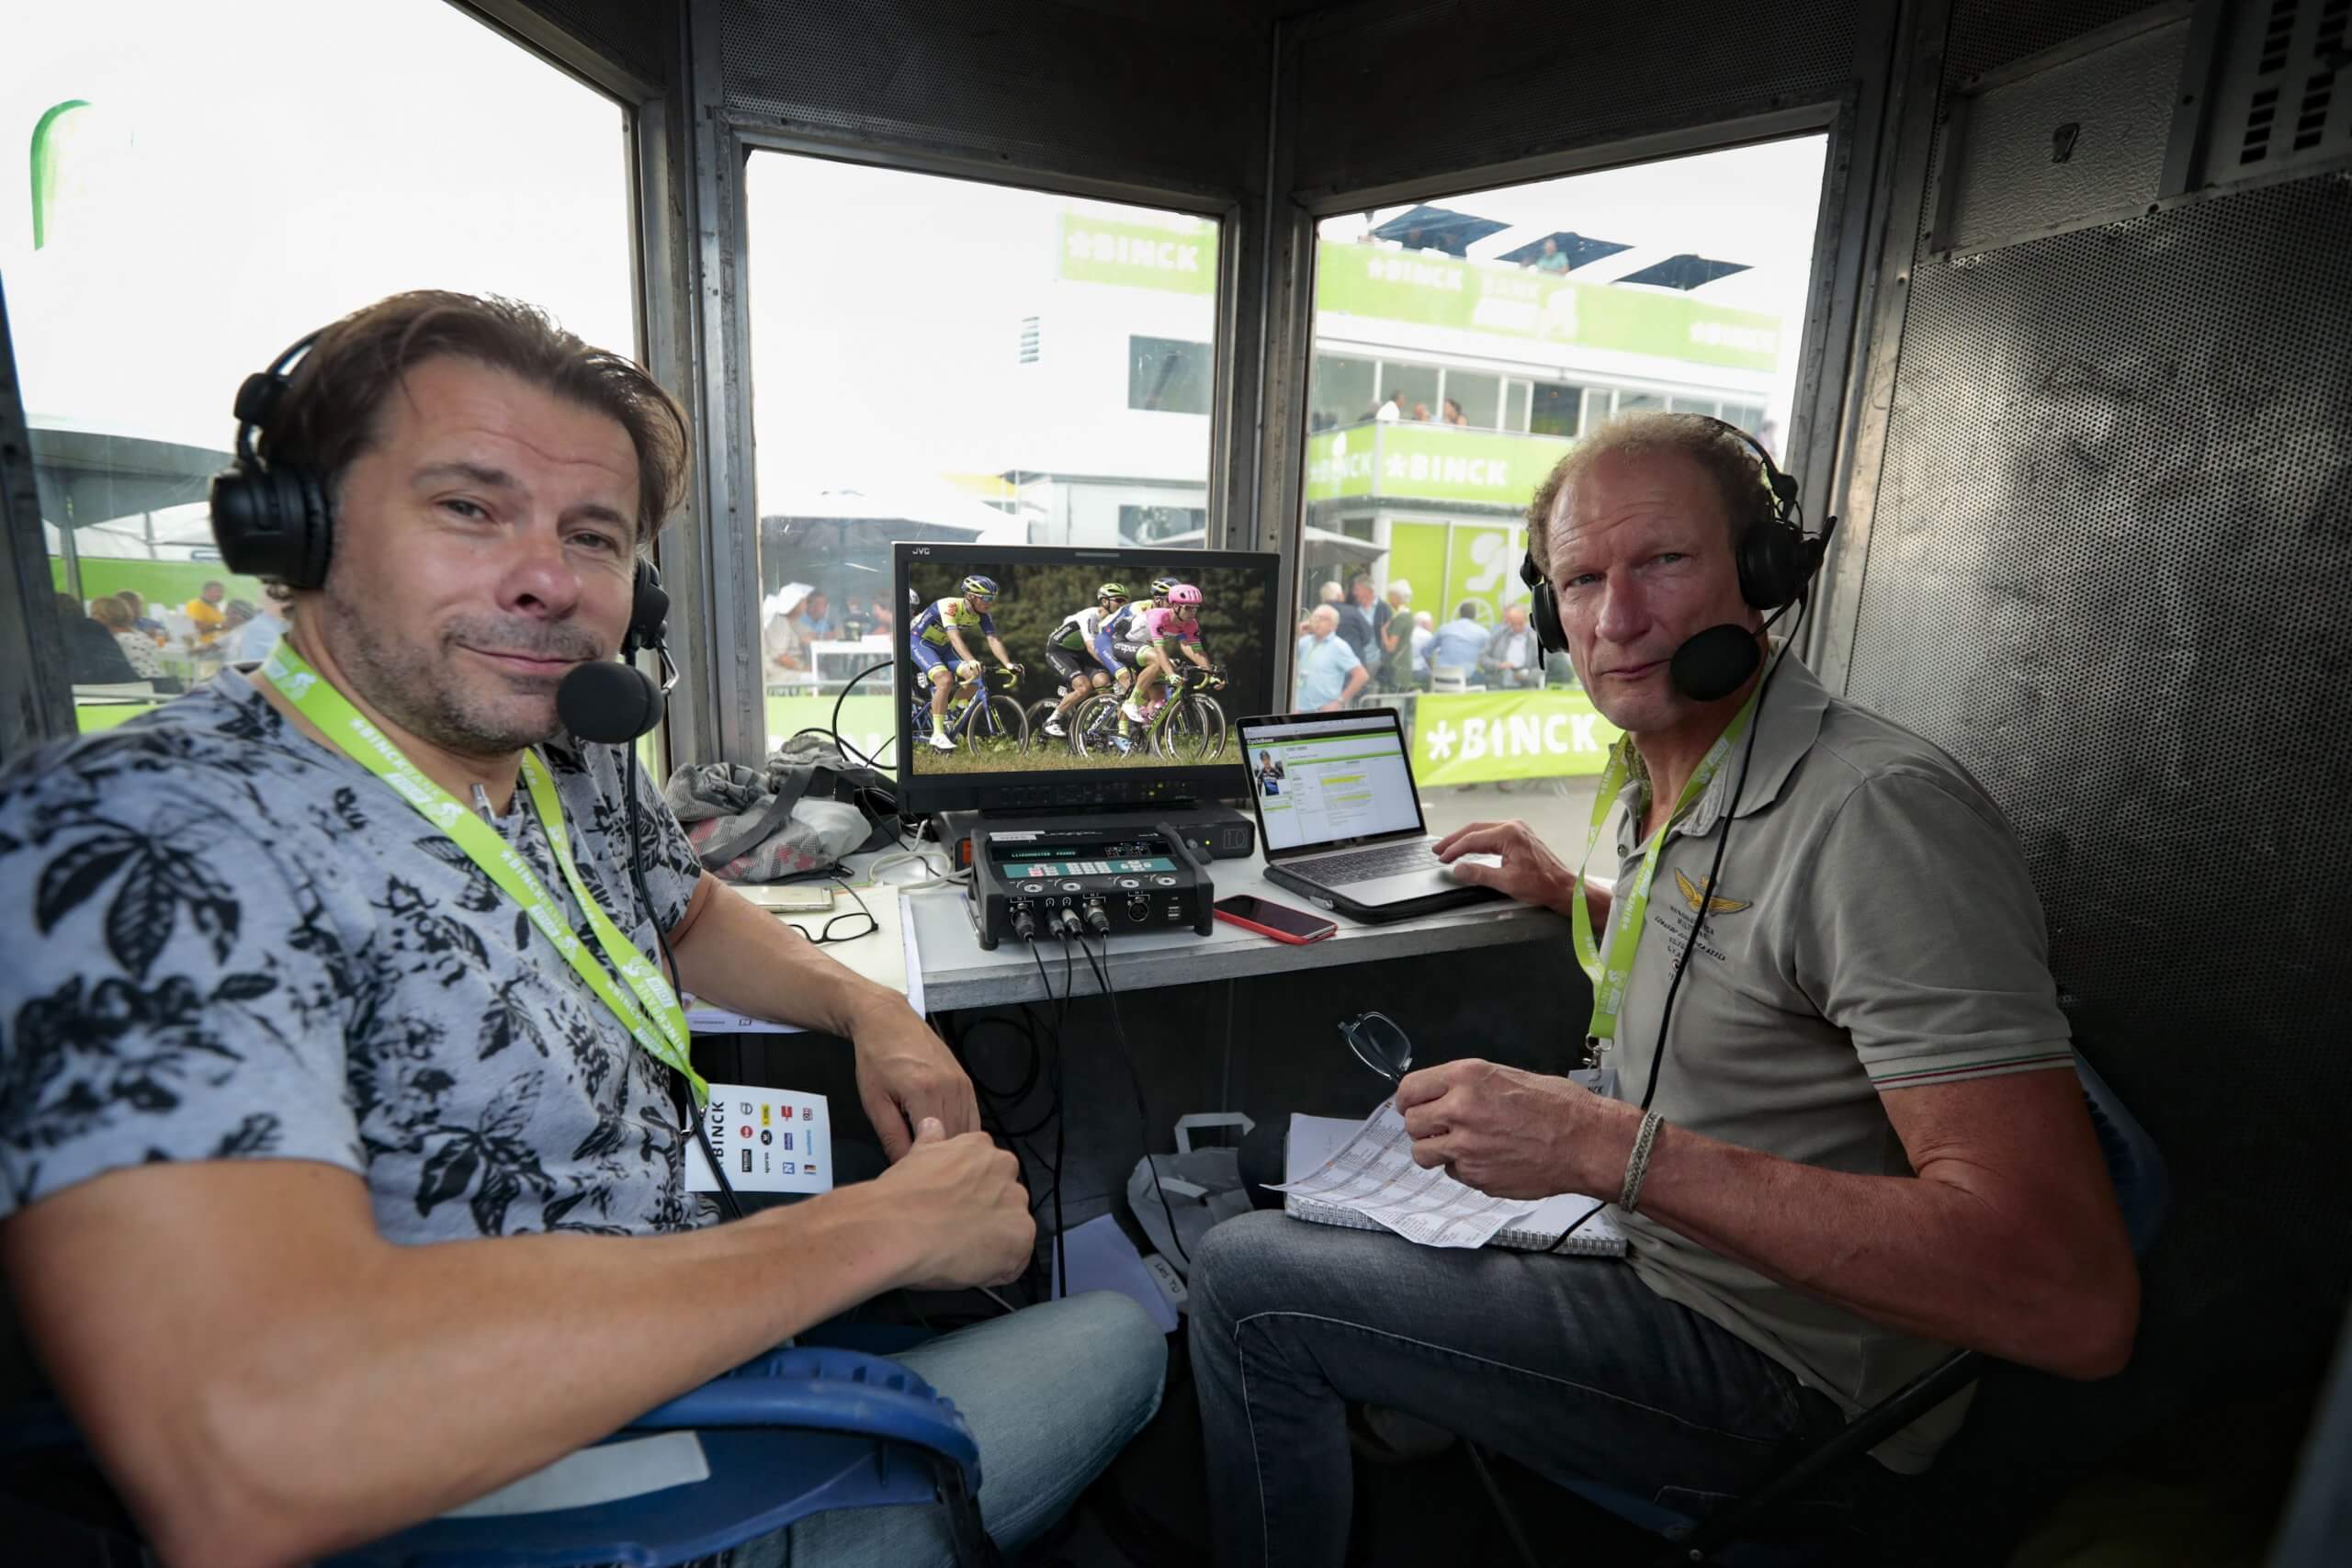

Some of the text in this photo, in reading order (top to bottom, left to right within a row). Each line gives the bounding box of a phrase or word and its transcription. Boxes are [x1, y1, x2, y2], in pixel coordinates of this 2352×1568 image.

[1093, 234, 1199, 272] BINCK
[1385, 260, 1463, 291] BINCK
[1323, 452, 1373, 481] BNCK
[1409, 453, 1508, 487] BINCK
[1460, 713, 1600, 761] BINCK
[712, 1102, 724, 1157] BINCK
